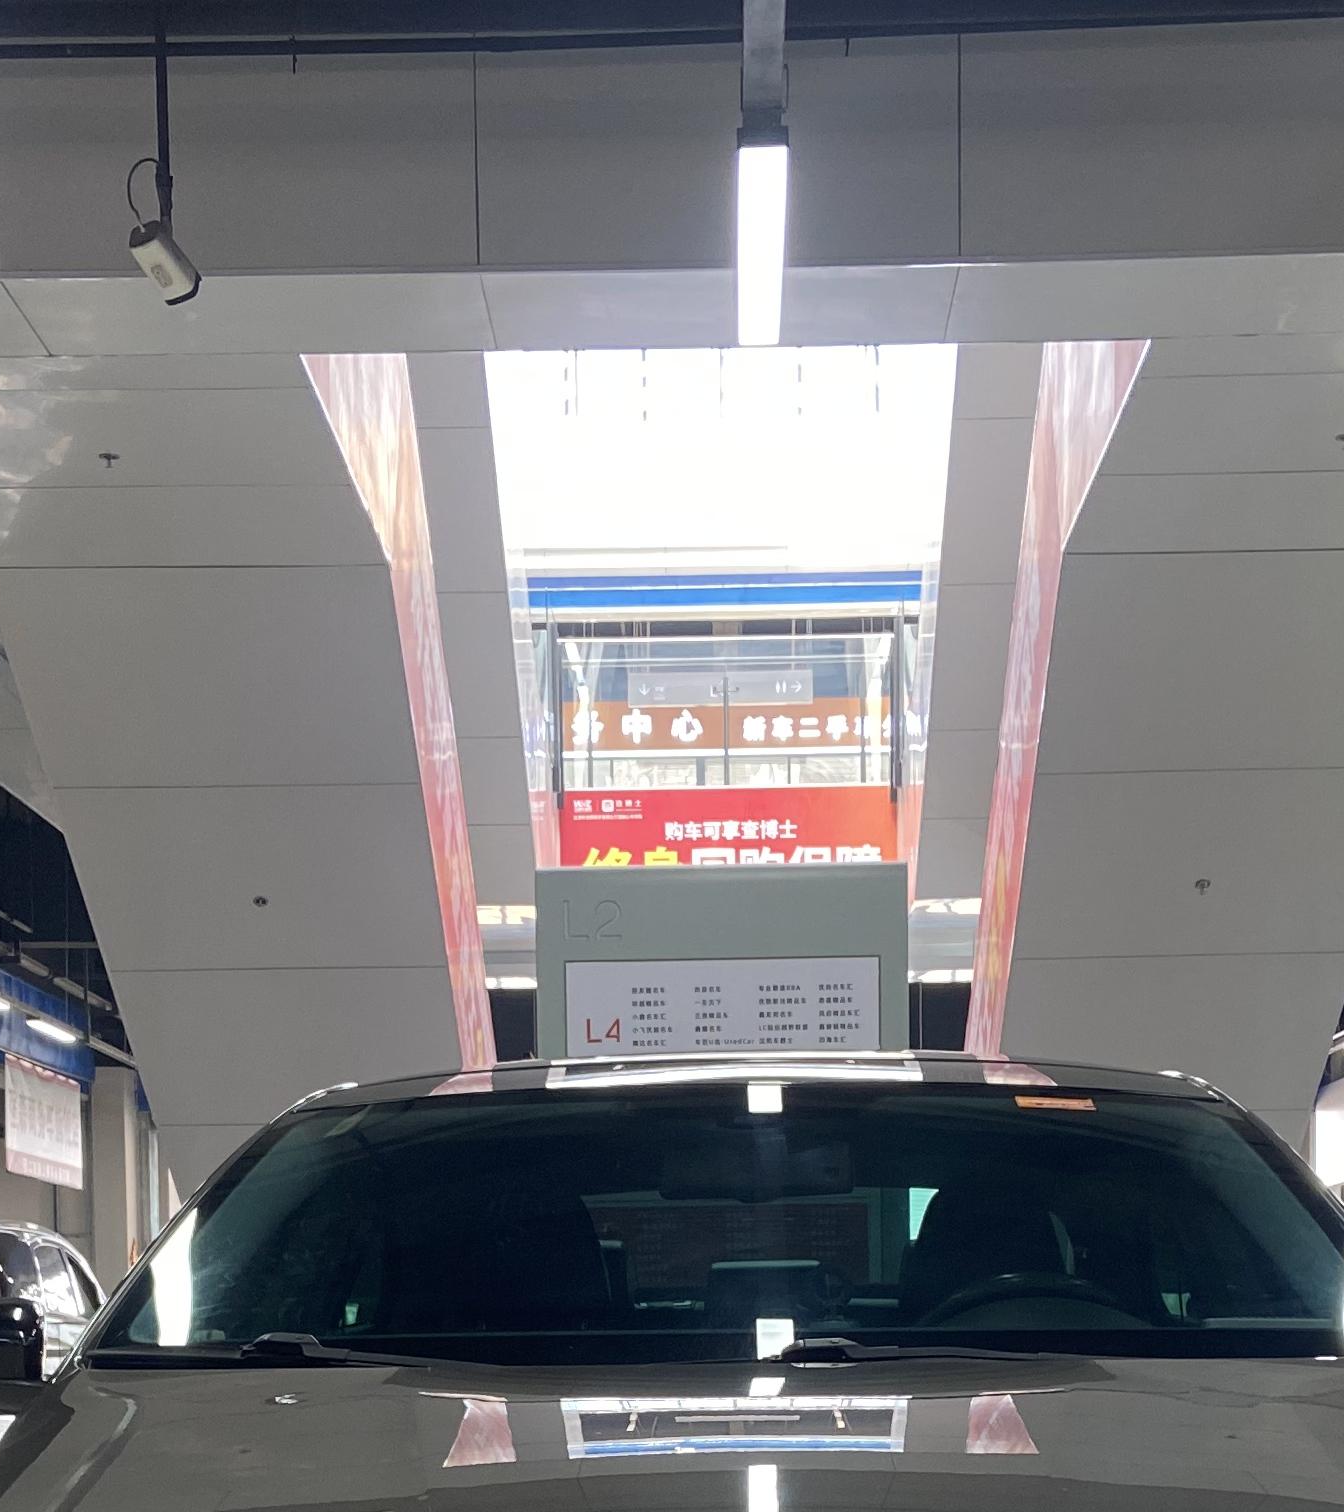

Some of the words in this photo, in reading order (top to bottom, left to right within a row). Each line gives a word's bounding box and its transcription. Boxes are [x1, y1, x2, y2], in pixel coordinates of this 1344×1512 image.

[664, 819, 798, 841] 购车可享查博士
[586, 1018, 621, 1043] L4
